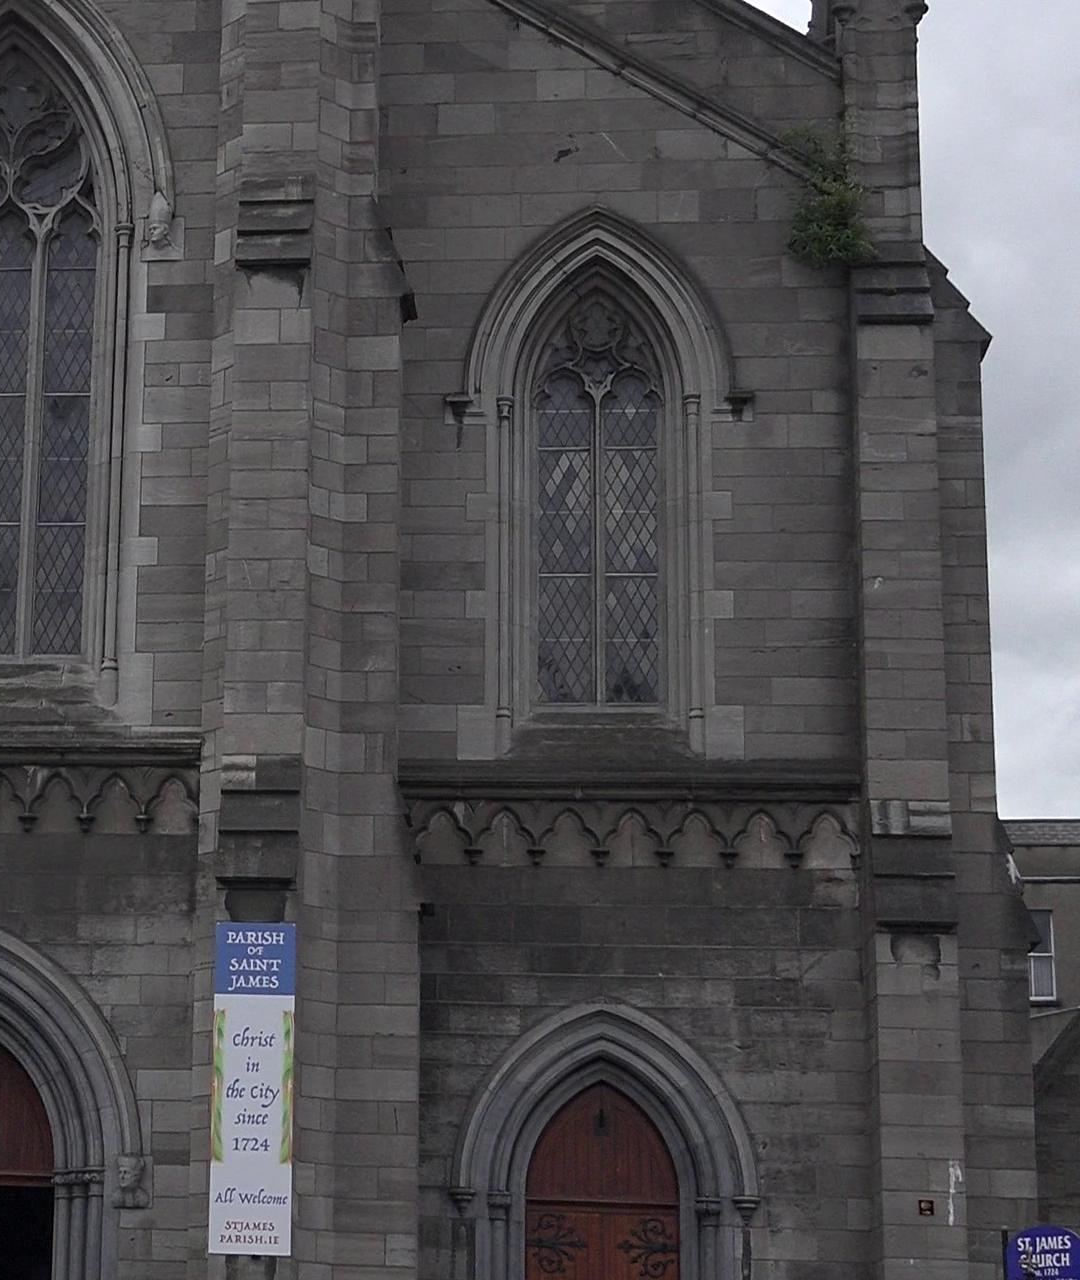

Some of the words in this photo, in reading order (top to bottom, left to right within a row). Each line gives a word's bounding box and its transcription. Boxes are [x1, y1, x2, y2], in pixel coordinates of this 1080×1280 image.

[227, 931, 285, 945] PARISH
[247, 946, 264, 955] OF
[229, 958, 282, 971] SAINT
[228, 975, 279, 991] JAMES
[232, 1026, 276, 1048] Christ
[245, 1056, 261, 1073] in
[226, 1078, 246, 1099] the
[234, 1108, 269, 1125] since
[232, 1137, 270, 1152] 1724
[214, 1187, 237, 1204] All
[238, 1188, 289, 1205] Welcome
[219, 1234, 280, 1245] PARISH.IE
[1017, 1237, 1033, 1252] ST.
[1035, 1235, 1072, 1254] JAMES
